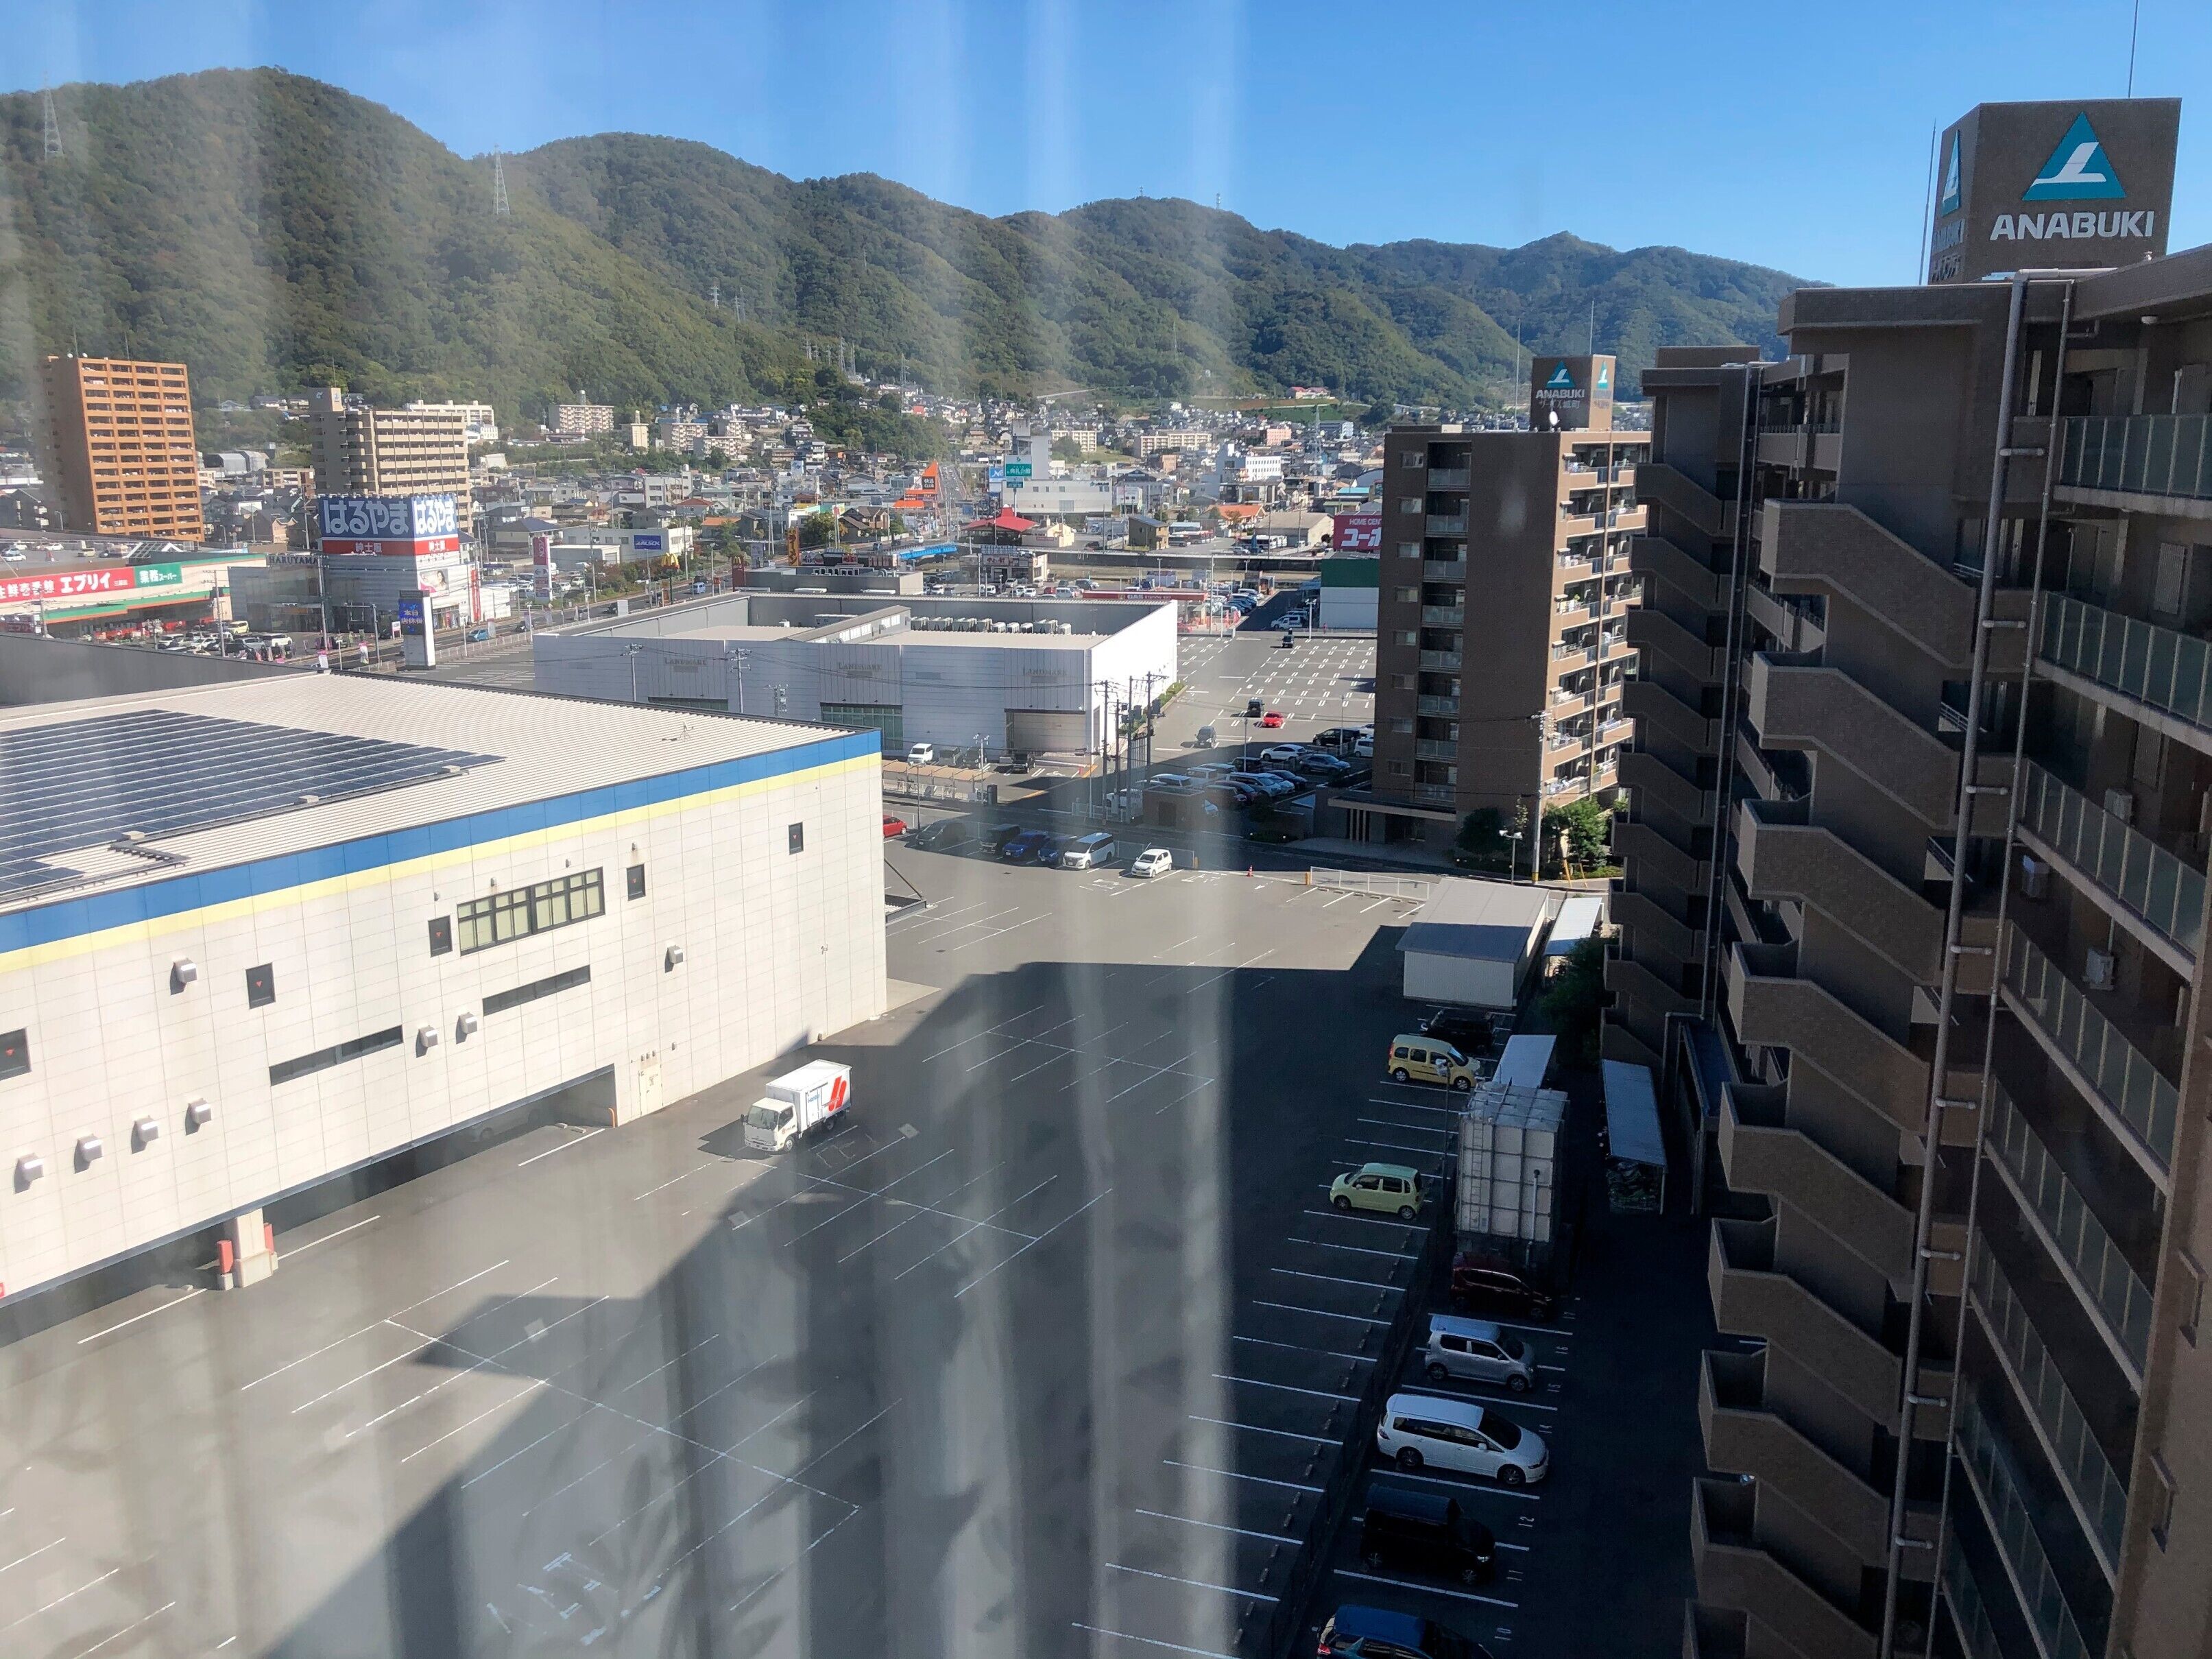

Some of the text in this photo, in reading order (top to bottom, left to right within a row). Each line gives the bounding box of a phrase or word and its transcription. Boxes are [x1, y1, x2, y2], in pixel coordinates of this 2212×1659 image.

[1990, 211, 2155, 241] ANABUKI
[1535, 389, 1585, 398] ANABUKI
[323, 499, 409, 535] はるやま
[413, 498, 455, 535] はるやま
[269, 556, 319, 564] HARUYAMA
[139, 569, 177, 584] 業務スーパー
[60, 572, 111, 594] エブリイ
[663, 656, 708, 665] LANDMARK
[839, 662, 882, 670] LANDMARK
[1539, 1424, 1553, 1435] 14
[1517, 1515, 1535, 1527] 12
[1506, 1569, 1524, 1581] 11
[1494, 1627, 1512, 1640] 10
